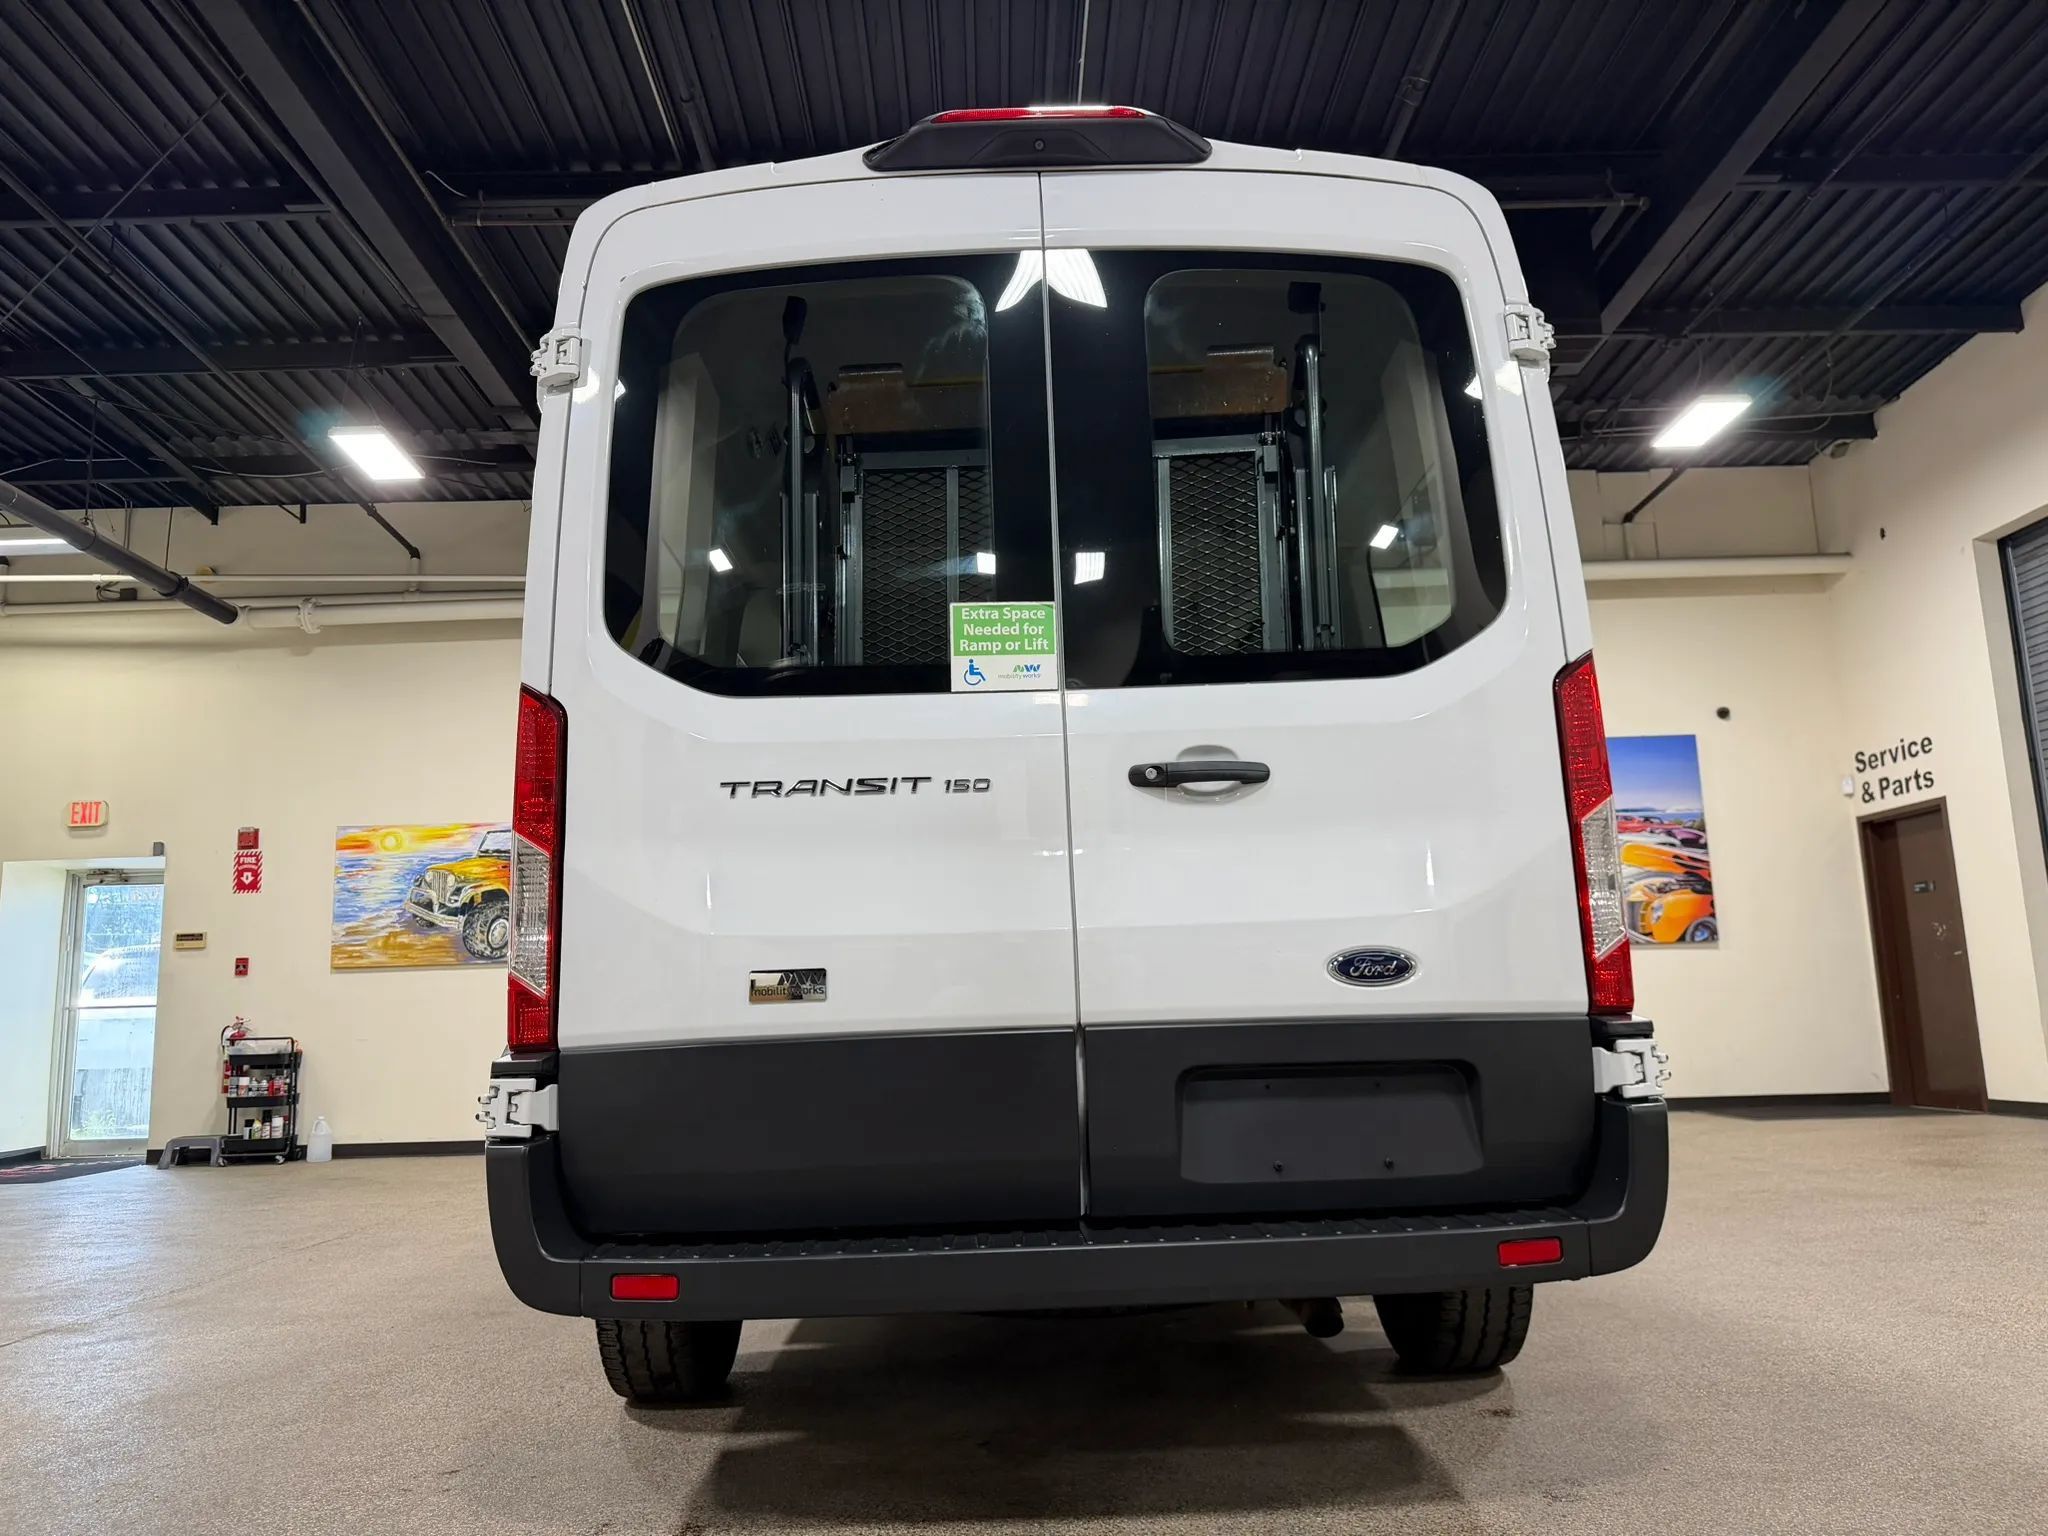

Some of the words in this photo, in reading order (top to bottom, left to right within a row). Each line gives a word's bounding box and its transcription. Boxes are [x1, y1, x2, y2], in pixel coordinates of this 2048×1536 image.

[962, 608, 999, 619] Extra
[1003, 606, 1046, 622] Space
[963, 623, 1020, 636] Needed
[1023, 622, 1045, 635] for
[960, 639, 1001, 653] Ramp
[1005, 642, 1021, 651] or
[1024, 637, 1049, 651] Lift
[1854, 736, 1933, 773] Service
[720, 776, 932, 799] TRANSIT
[944, 778, 991, 794] 150
[1862, 781, 1875, 804] &
[1878, 768, 1934, 799] Parts
[71, 801, 102, 825] EXIT
[240, 856, 257, 864] FIRE
[1349, 956, 1397, 977] Ford
[751, 984, 825, 998] mobilitorks
